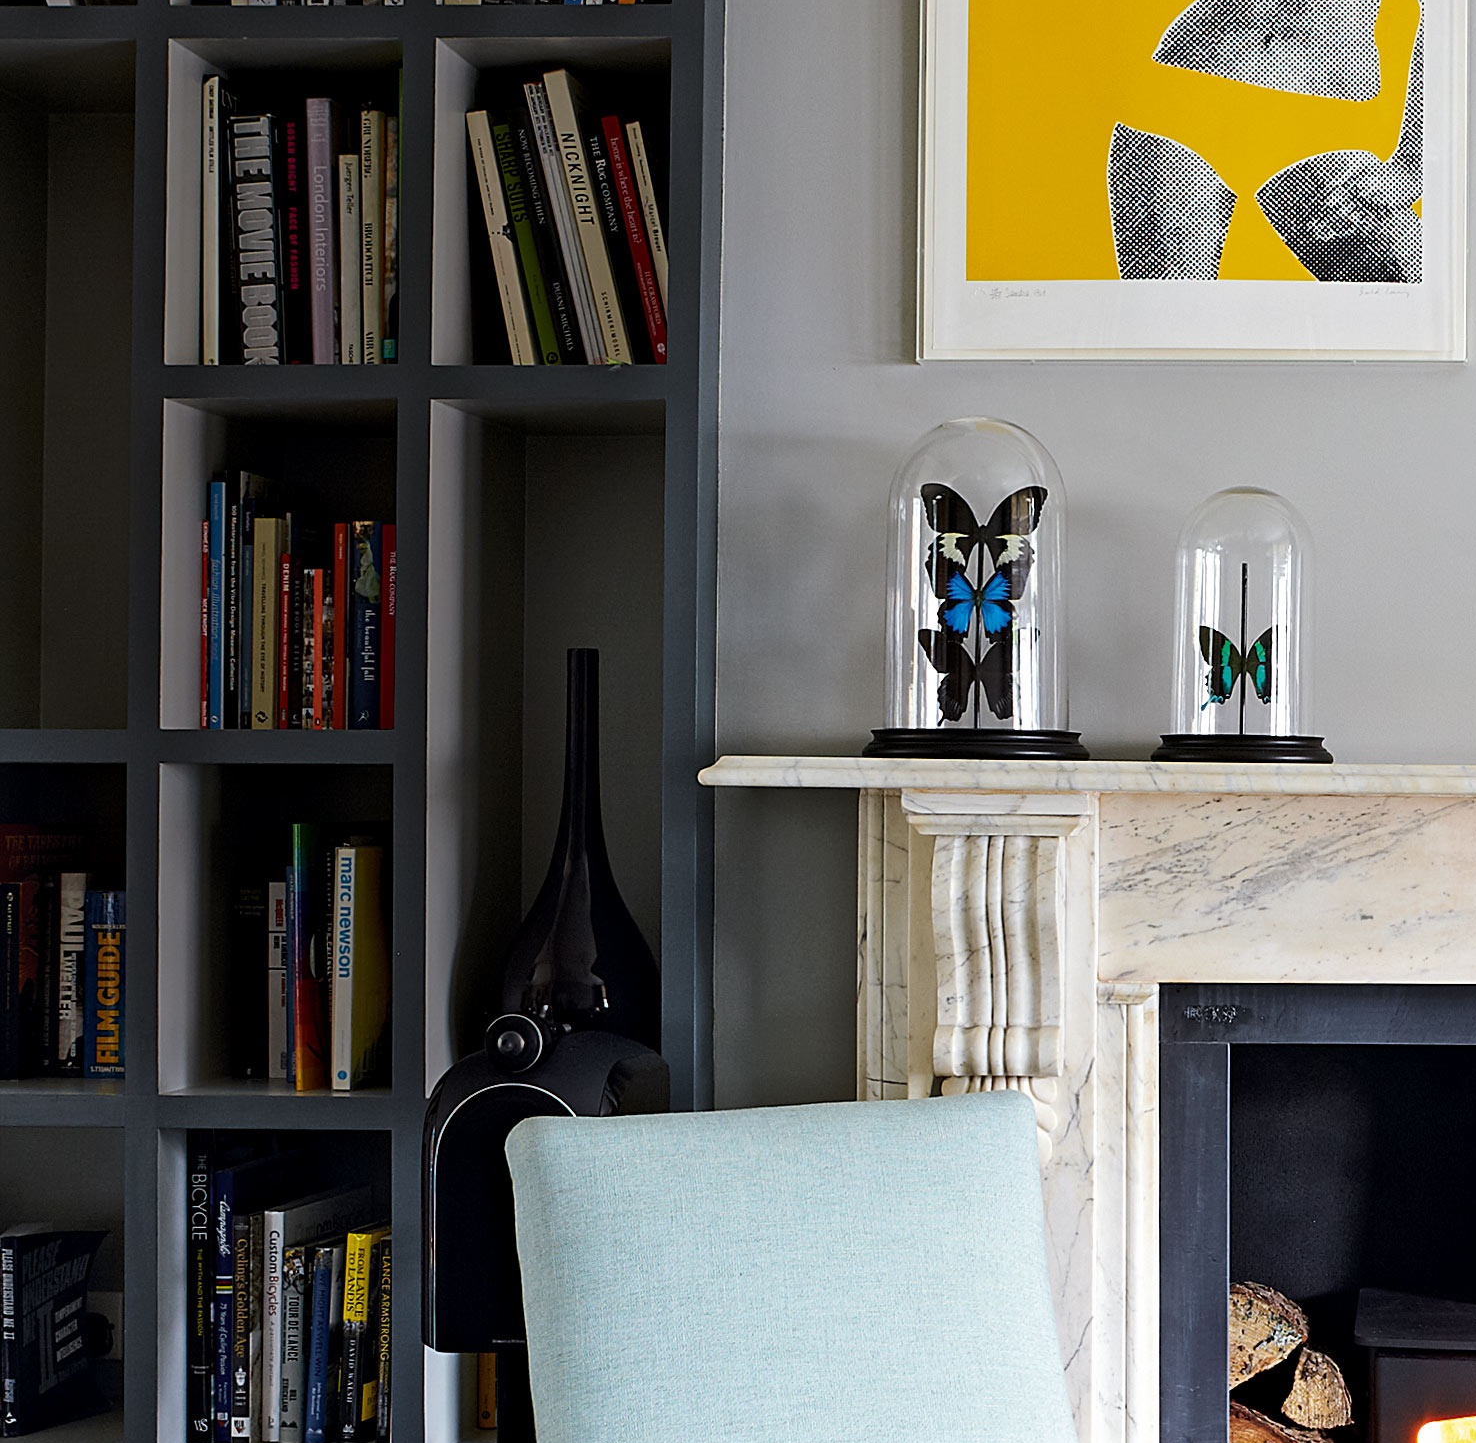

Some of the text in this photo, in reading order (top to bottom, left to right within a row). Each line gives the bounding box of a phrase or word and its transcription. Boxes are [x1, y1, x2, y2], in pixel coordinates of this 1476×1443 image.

[363, 118, 372, 179] GRUNDBERG
[495, 131, 529, 223] SHARP SUITS
[560, 133, 594, 225] NICKNIGHT
[345, 163, 354, 214] Juergen Teller
[589, 135, 618, 233] THE RUG COMPANY
[609, 137, 642, 244] home is where the heart is?
[234, 118, 279, 365] THE MOVIE BOOK
[313, 166, 329, 292] London Interiors
[365, 223, 373, 286] BRODOVITCH
[647, 203, 661, 252] Marcel Breuer
[282, 563, 290, 591] DENIM
[361, 609, 375, 681] the beautiful fall
[60, 899, 85, 957] PAUL
[339, 857, 352, 978] marc newson
[58, 954, 73, 1020] WELLER
[96, 931, 121, 1064] FILM GUIDE
[191, 1174, 207, 1240] BICYCLE
[235, 1238, 247, 1358] Cycling's Golden Age
[268, 1230, 280, 1315] Custom Bicycles
[347, 1252, 355, 1312] TO LANDIS
[355, 1277, 365, 1317] LANCE
[287, 1296, 299, 1362] TOUR DE LANCE
[380, 1256, 390, 1361] LANCE ARMSTRONG
[346, 1339, 356, 1403] DAVID WALSH
